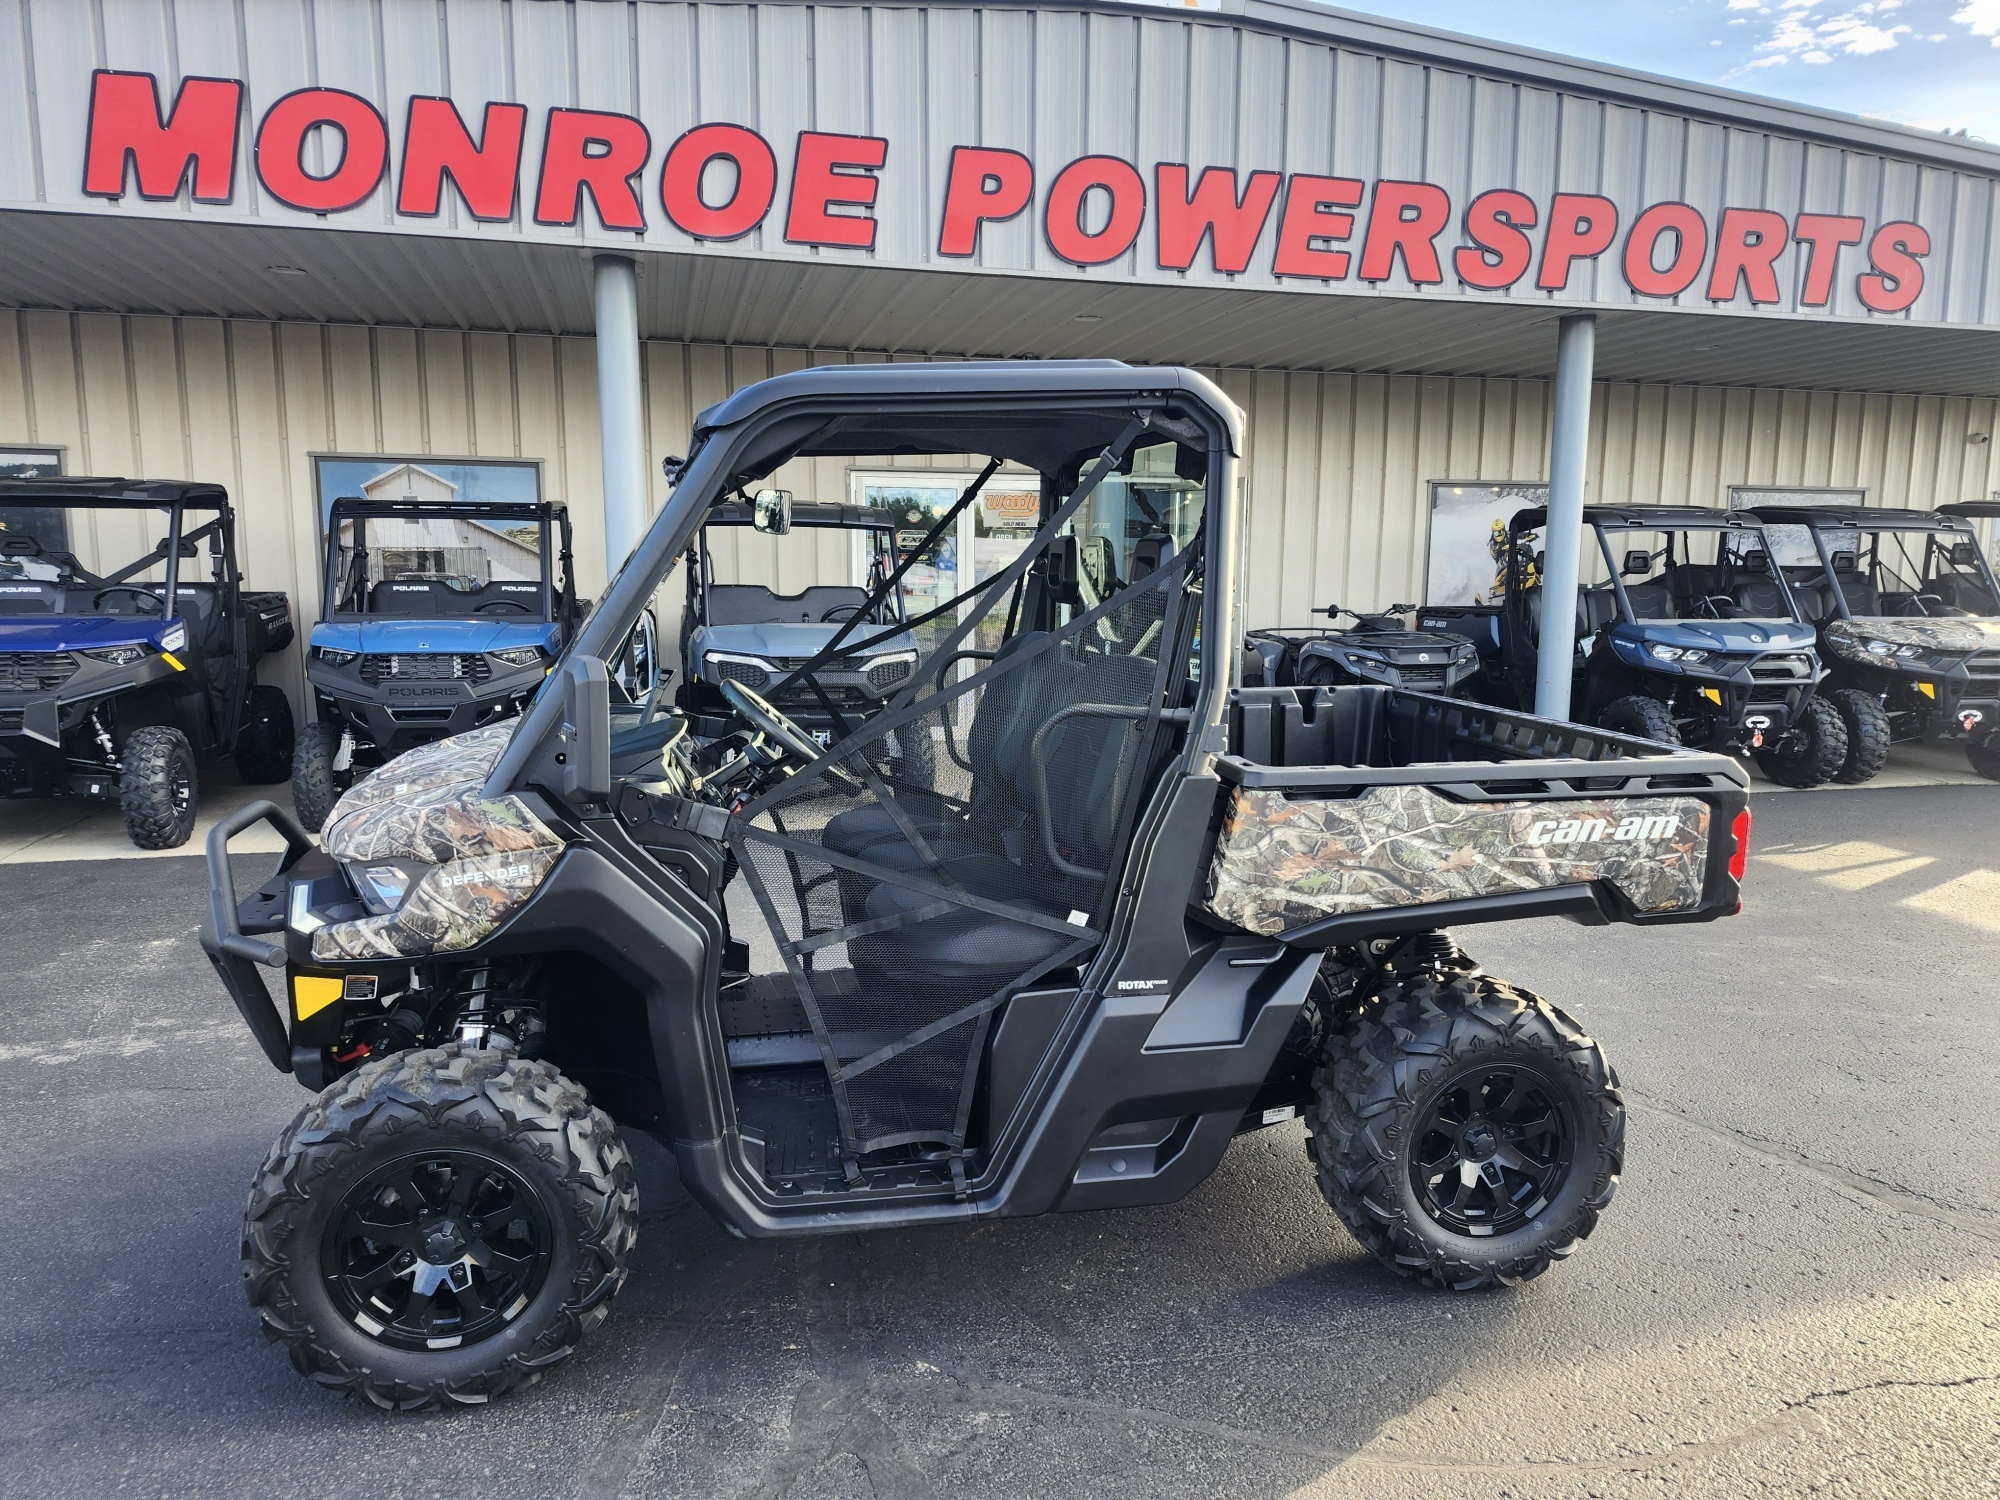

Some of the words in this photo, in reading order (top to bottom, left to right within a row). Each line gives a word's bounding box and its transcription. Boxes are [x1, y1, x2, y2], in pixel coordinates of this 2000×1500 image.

[83, 69, 889, 250] MONROE
[938, 145, 1931, 314] POWERSPORTS
[996, 533, 1013, 541] OPEN
[501, 585, 538, 593] POLARIS
[267, 616, 289, 630] RANGER
[1423, 619, 1447, 628] can-am
[164, 634, 183, 646] 1000
[1614, 639, 1635, 648] DEFENDER
[388, 687, 460, 698] POLARIS
[370, 783, 408, 802] HD9
[1527, 815, 1680, 846] can-am
[441, 864, 530, 888] DEFENDER
[1118, 980, 1153, 990] ROTAX
